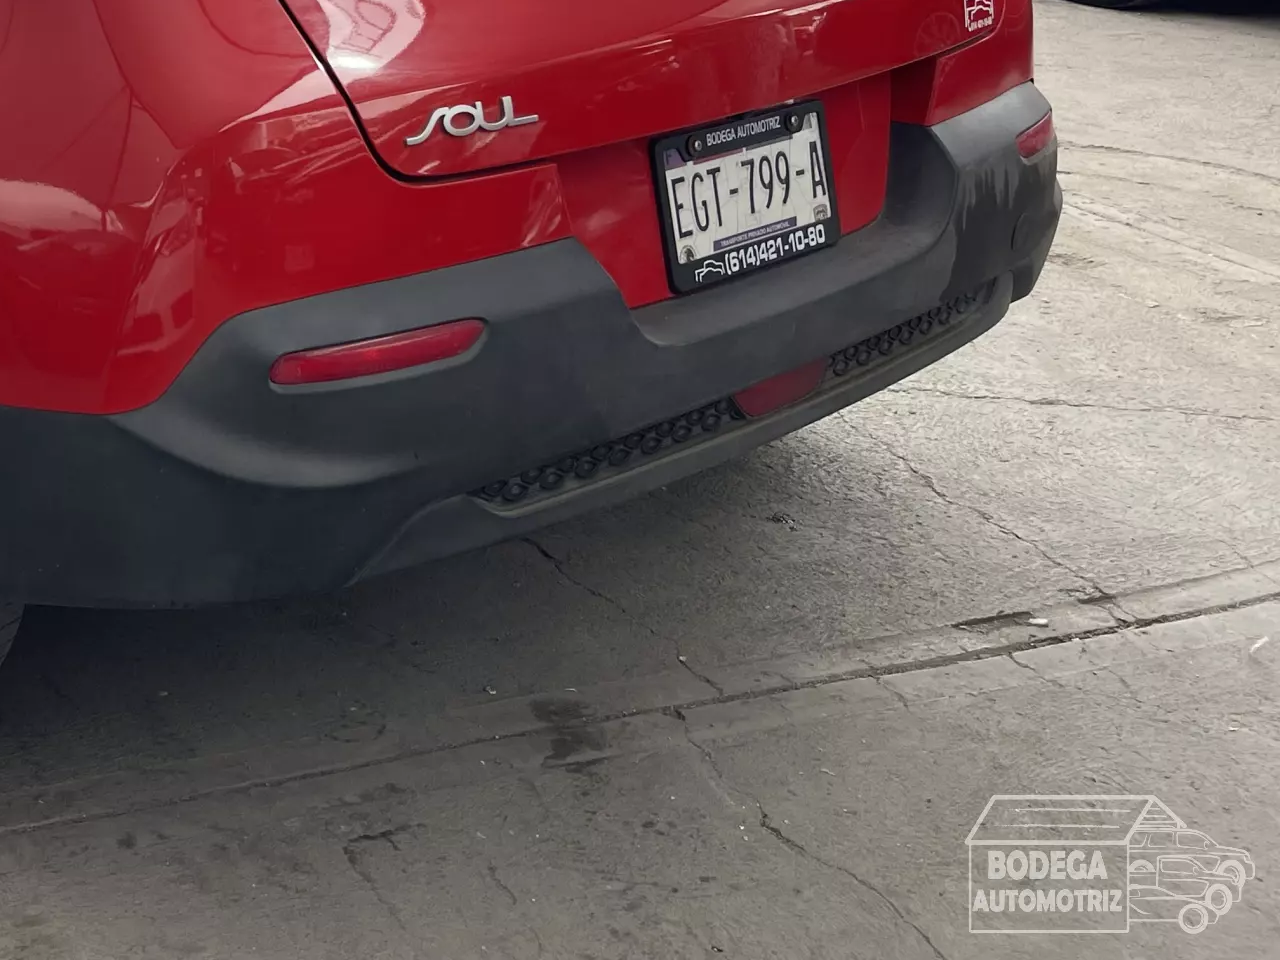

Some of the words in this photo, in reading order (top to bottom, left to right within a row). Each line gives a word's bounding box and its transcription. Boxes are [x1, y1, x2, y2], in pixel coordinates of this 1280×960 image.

[405, 95, 539, 146] SOUL
[706, 128, 736, 147] BODEGA
[737, 116, 781, 138] AUTOMOTRIZ
[671, 141, 826, 238] EGT-799-A
[724, 224, 826, 276] (614)421-10-80
